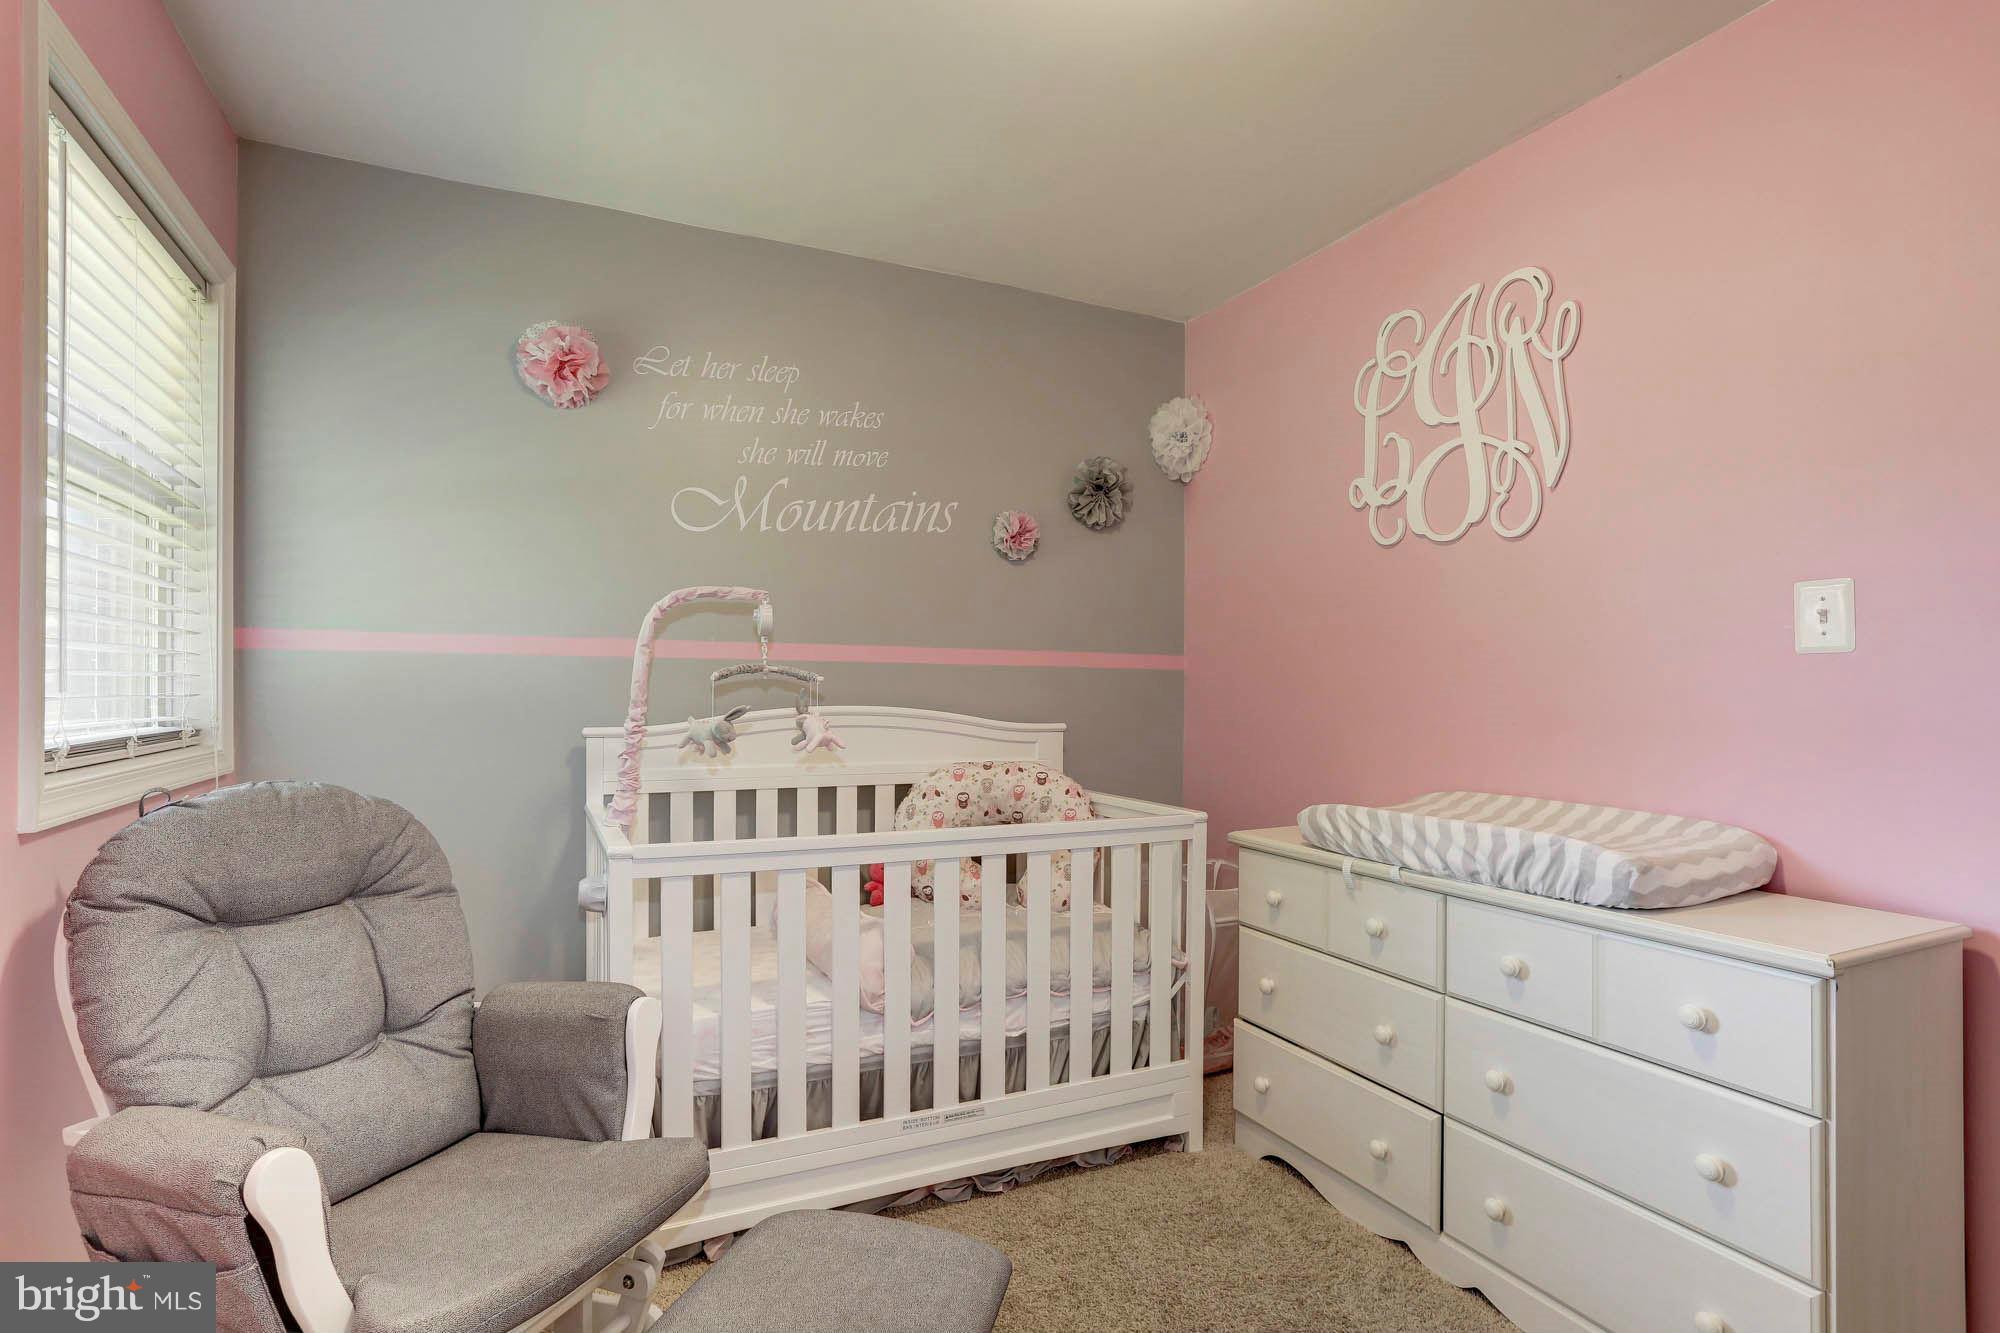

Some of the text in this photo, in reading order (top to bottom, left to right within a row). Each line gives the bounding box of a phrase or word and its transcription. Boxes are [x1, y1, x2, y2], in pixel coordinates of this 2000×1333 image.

[632, 345, 800, 393] Let her sleep
[647, 391, 885, 430] for when she wakes
[737, 436, 889, 468] she will move
[670, 475, 959, 533] Mountains
